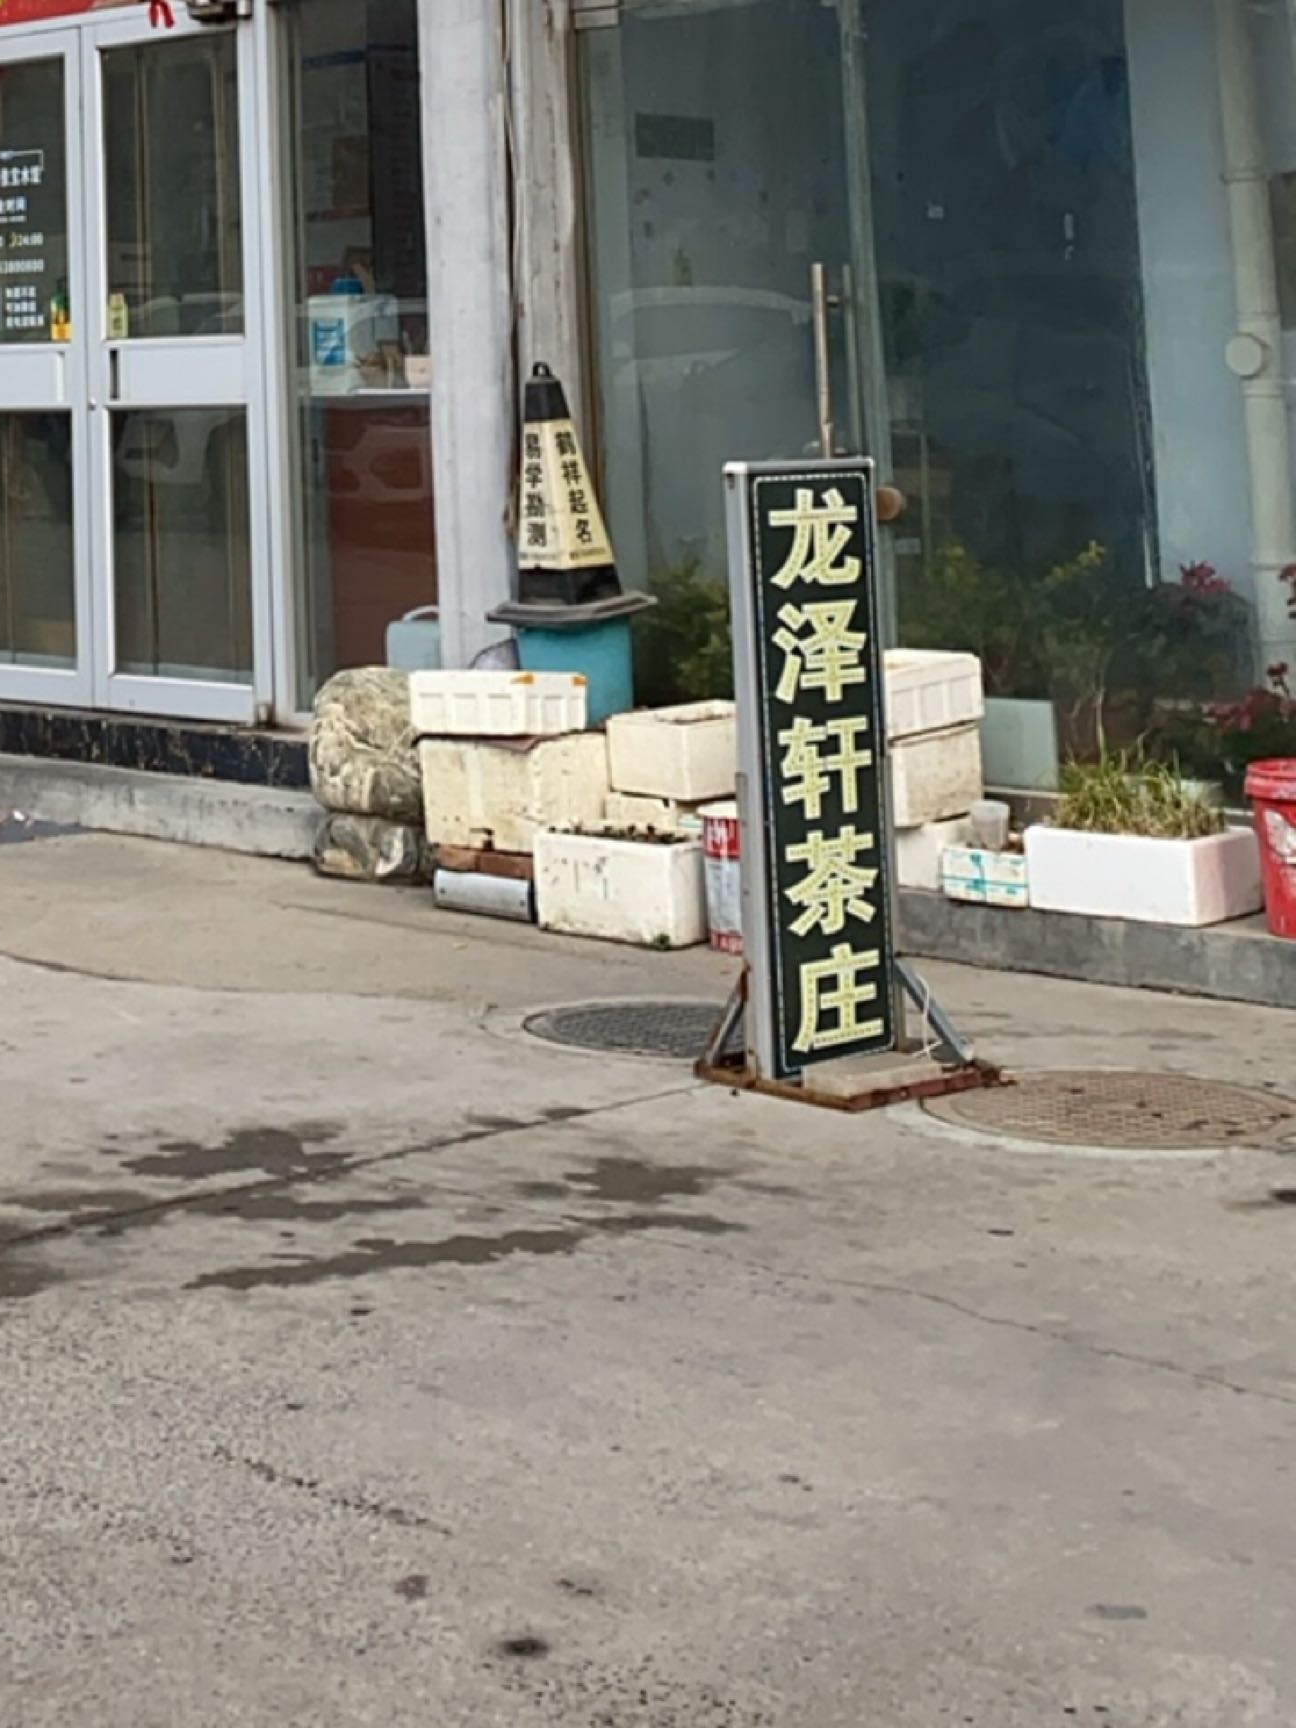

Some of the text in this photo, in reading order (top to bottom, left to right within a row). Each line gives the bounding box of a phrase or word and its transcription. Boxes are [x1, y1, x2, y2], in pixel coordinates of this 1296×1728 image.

[767, 486, 885, 1054] 龙泽轩茶庄
